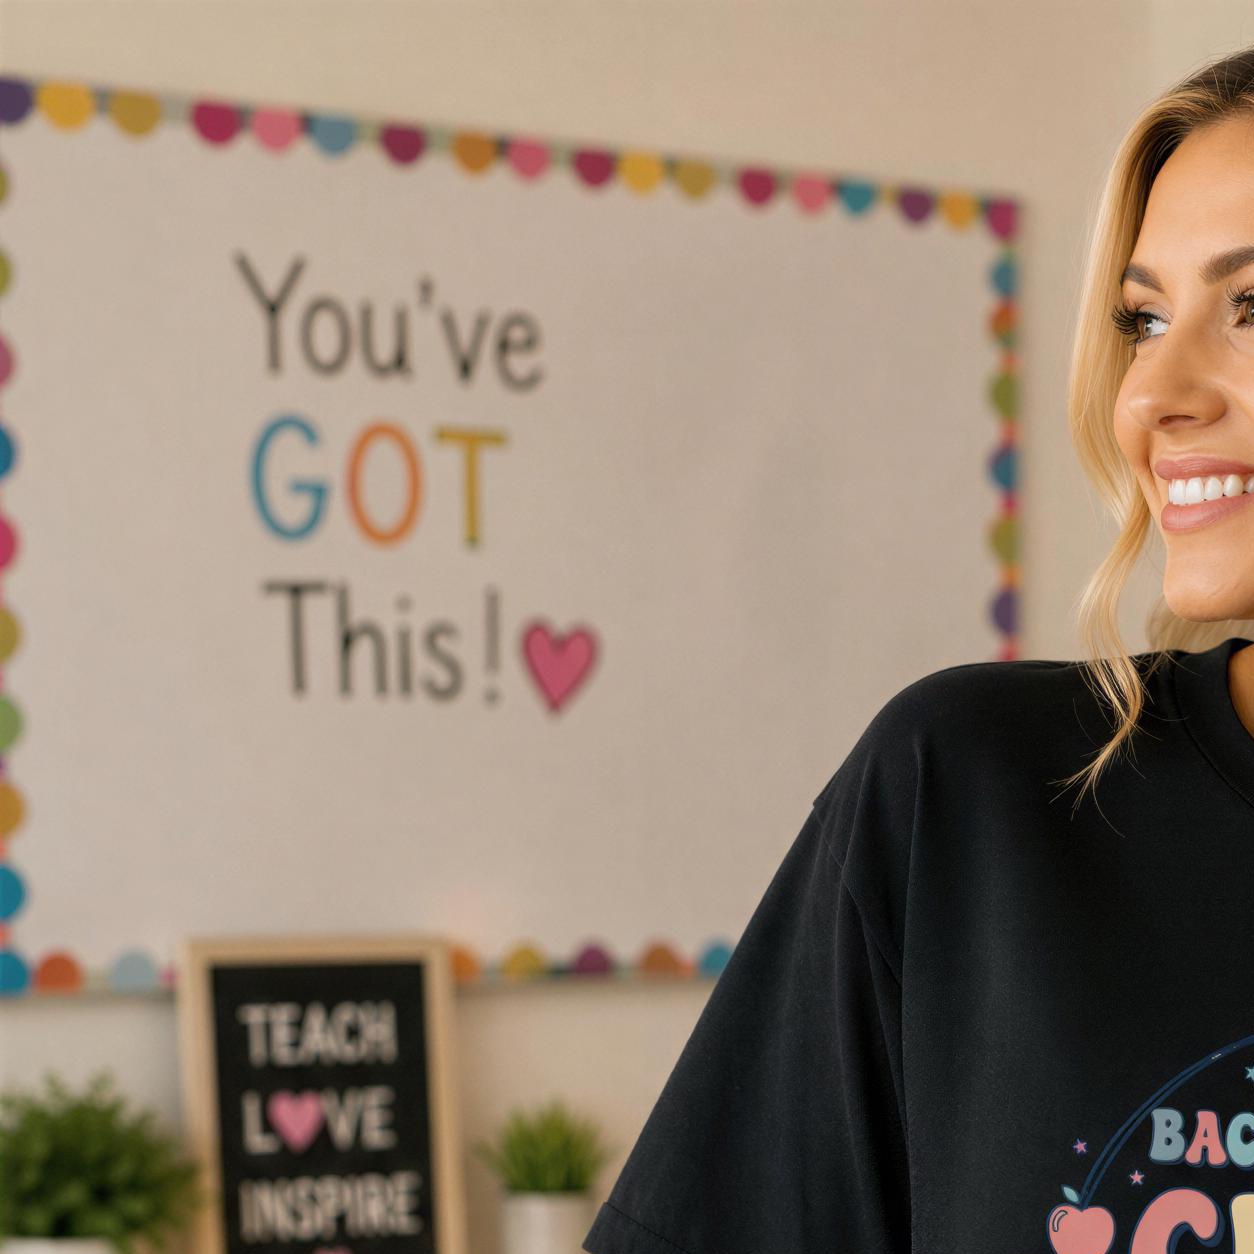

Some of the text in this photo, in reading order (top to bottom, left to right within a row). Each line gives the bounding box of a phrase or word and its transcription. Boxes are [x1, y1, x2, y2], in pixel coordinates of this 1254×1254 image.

[234, 252, 545, 392] You've
[250, 411, 508, 551] GOT
[261, 577, 502, 707] This!
[237, 1001, 399, 1069] TEACH
[241, 1085, 398, 1155] LVE
[239, 1170, 424, 1245] INSPIRE
